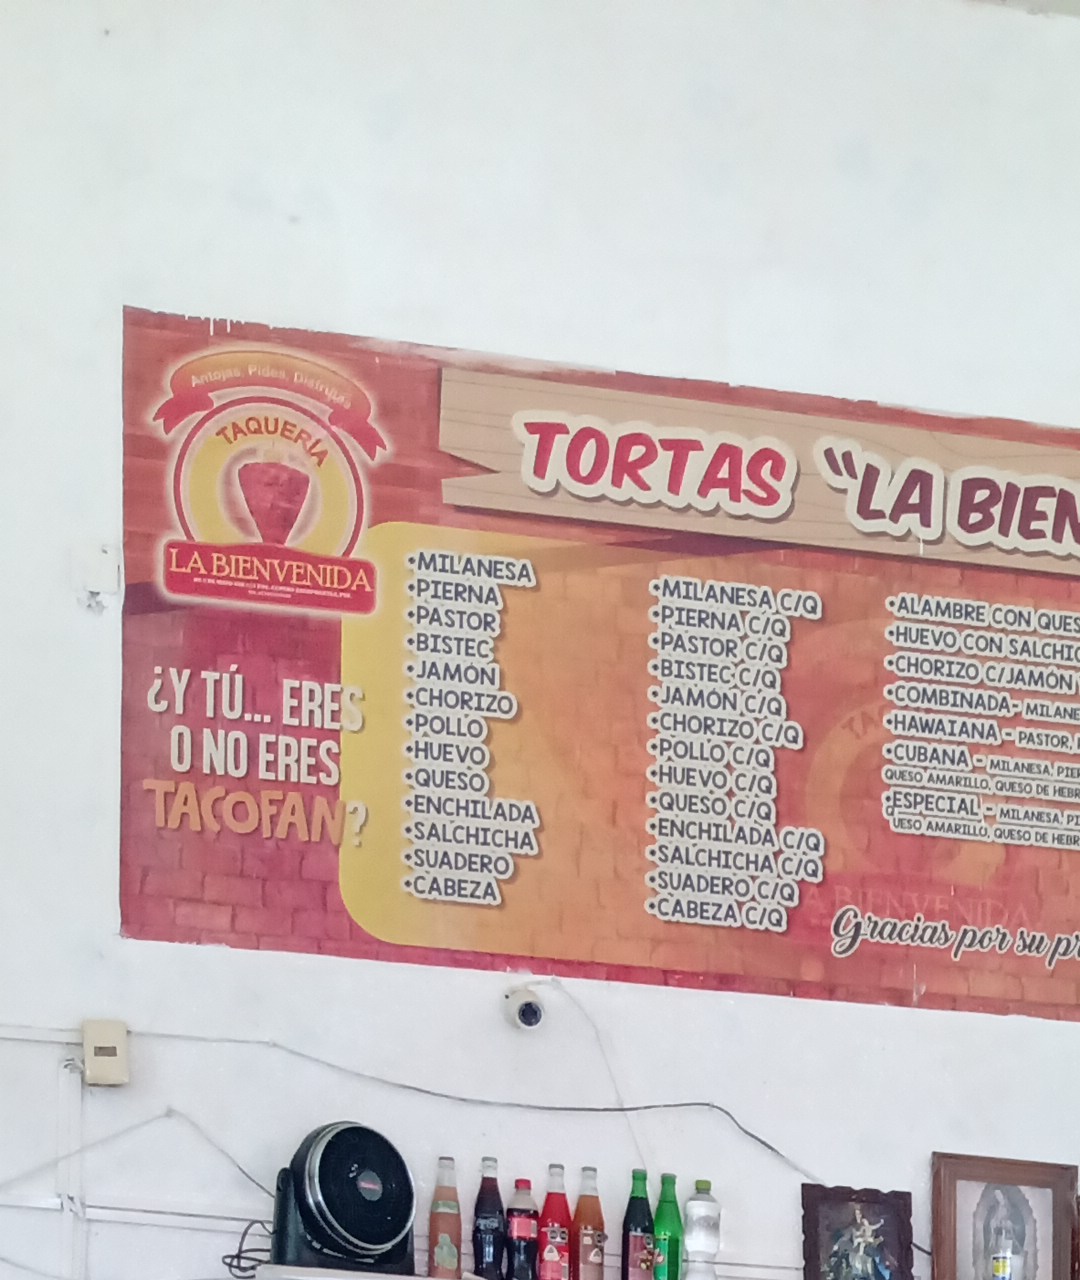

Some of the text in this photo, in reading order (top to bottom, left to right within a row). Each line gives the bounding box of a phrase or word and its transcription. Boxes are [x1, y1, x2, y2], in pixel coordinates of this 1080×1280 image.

[216, 416, 329, 468] TAQUERÍA
[523, 422, 786, 506] TORTAS
[169, 548, 208, 574] LA
[211, 552, 374, 592] BIENVENIDA
[780, 592, 818, 616] C/Q
[748, 616, 787, 638] C/Q
[992, 607, 1032, 628] CON
[746, 642, 784, 664] C/Q
[963, 633, 1003, 654] CON
[738, 668, 777, 690] C/Q
[985, 666, 1073, 691] C/JAMÓN
[147, 664, 366, 732] ¿Y TÚ... ERES
[744, 695, 782, 716] C/Q
[762, 723, 800, 744] C/Q
[170, 725, 340, 786] O NO ERES
[732, 746, 770, 768] C/Q
[735, 772, 773, 794] C/Q
[884, 768, 922, 782] QUESO
[995, 779, 1032, 794] QUESO
[1036, 784, 1050, 796] DE
[734, 800, 772, 821] C/Q
[782, 830, 821, 852] C/Q
[994, 828, 1032, 842] QUESO
[1034, 832, 1048, 844] DE
[781, 857, 820, 878] C/Q
[757, 880, 795, 902] C/Q
[745, 906, 784, 928] C/Q
[833, 906, 953, 955] Gracias
[953, 925, 1010, 959] por
[1016, 929, 1048, 954] su
